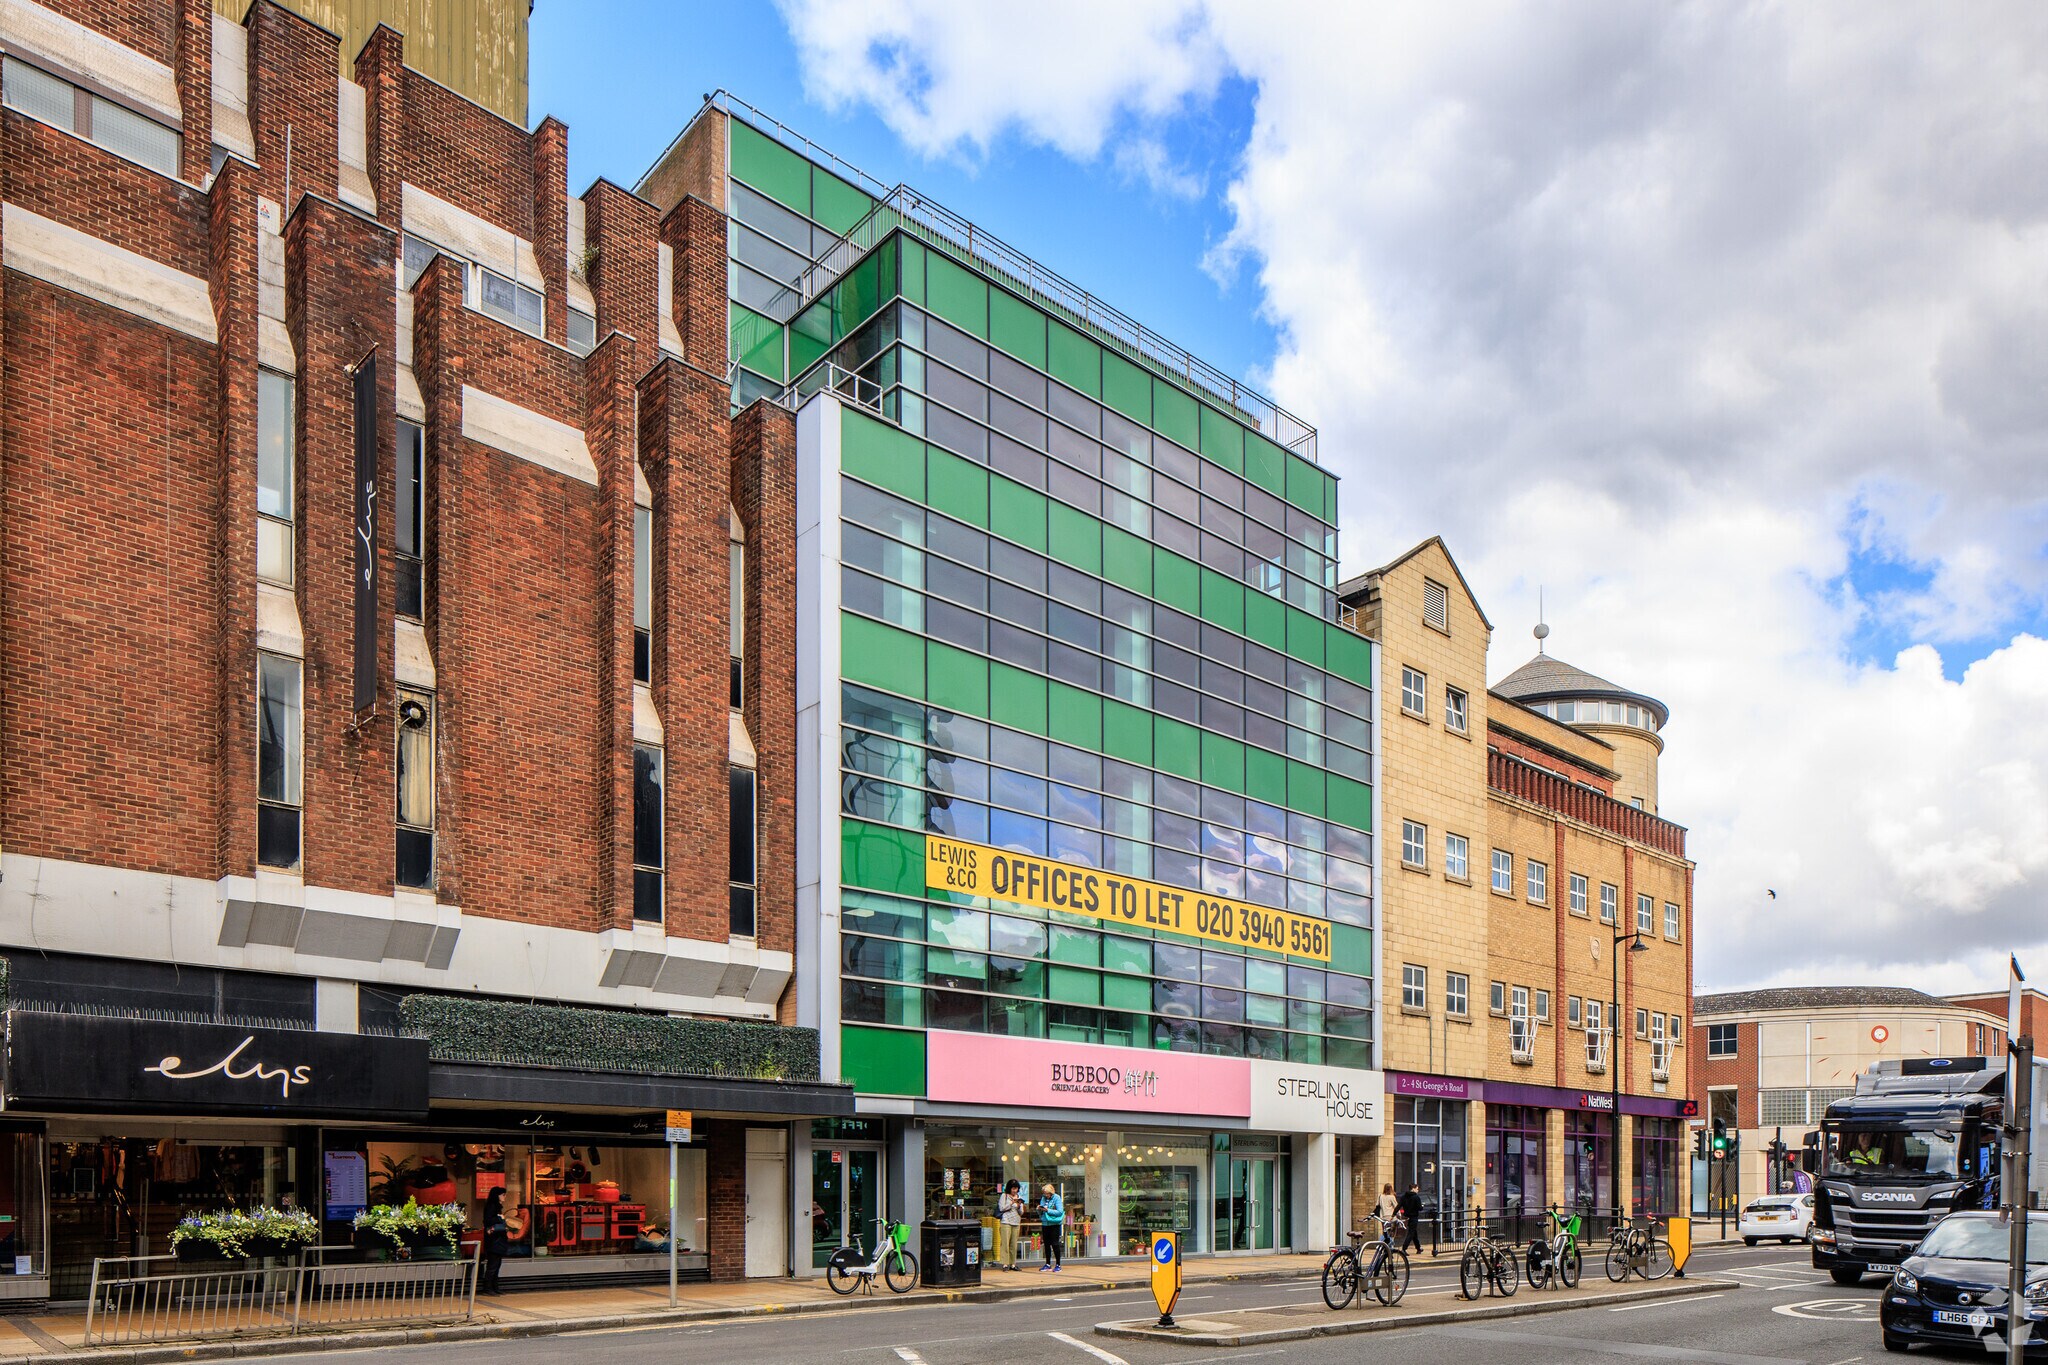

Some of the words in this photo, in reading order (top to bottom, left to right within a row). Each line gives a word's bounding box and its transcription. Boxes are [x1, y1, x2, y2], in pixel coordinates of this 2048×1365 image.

[357, 479, 377, 590] elys
[930, 841, 977, 869] LEWIS
[946, 865, 977, 889] &CO
[991, 855, 1099, 912] OFFICES
[1106, 879, 1137, 919] TO
[1145, 888, 1184, 928] LET
[1196, 899, 1233, 938] 020
[1239, 908, 1285, 948] 3940
[1290, 920, 1329, 957] 5561
[144, 1035, 311, 1098] elys
[1051, 1063, 1121, 1086] BUBBOO
[1051, 1083, 1082, 1093] ORIENTAL
[1082, 1085, 1110, 1095] GROCERY
[1277, 1078, 1350, 1100] STERLING
[1401, 1078, 1407, 1088] 2
[1411, 1079, 1415, 1089] 4
[1415, 1079, 1422, 1089] St
[1422, 1080, 1449, 1093] George's
[1449, 1082, 1464, 1093] Road
[1326, 1099, 1373, 1119] HOUSE
[1588, 1094, 1613, 1109] NatWest
[520, 1114, 555, 1129] elys
[1861, 1192, 1917, 1202] SCANIA
[1939, 1312, 1968, 1323] LH66
[1970, 1314, 1992, 1325] CFA
